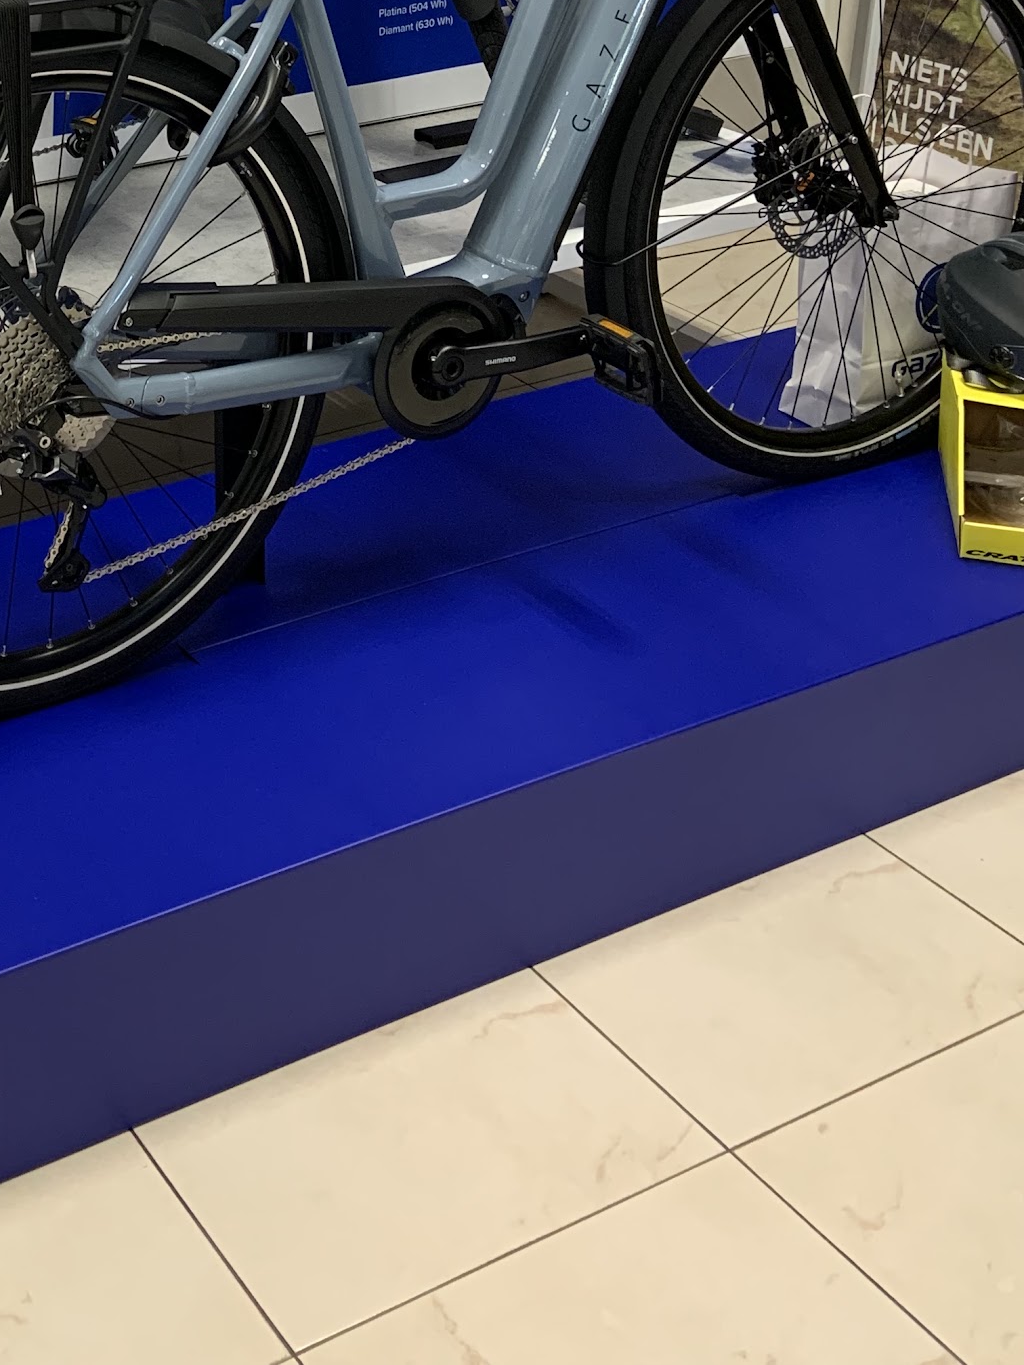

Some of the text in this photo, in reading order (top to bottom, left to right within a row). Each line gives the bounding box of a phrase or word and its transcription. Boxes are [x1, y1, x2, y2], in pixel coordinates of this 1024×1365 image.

[378, 6, 407, 18] Platina
[408, 1, 428, 14] (504
[378, 15, 453, 36] Diamant (630 Wh)
[889, 51, 969, 92] NIETS
[886, 79, 963, 120] RIJDT
[881, 109, 933, 142] ALS
[485, 356, 517, 366] SHIMANO
[966, 549, 1024, 562] CRA
